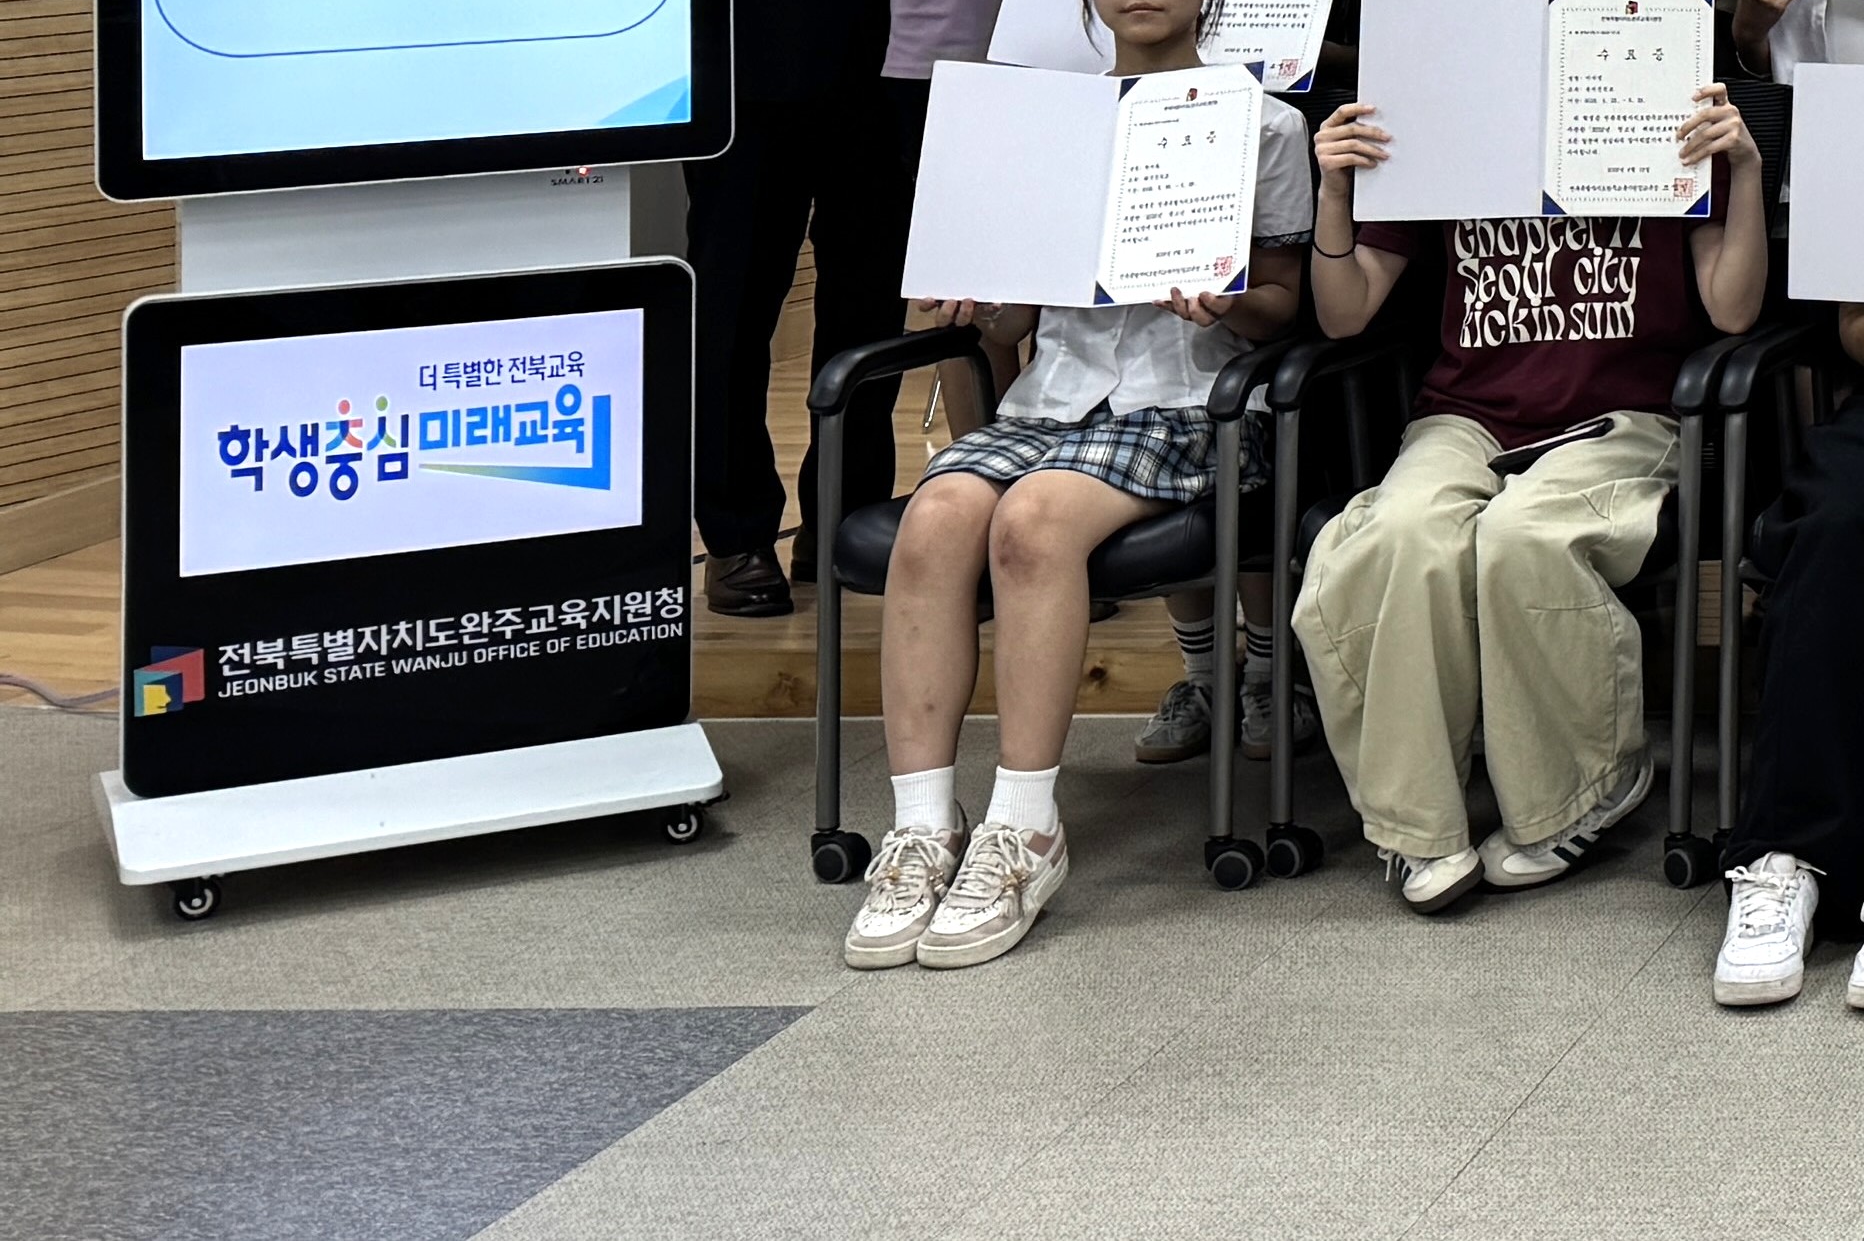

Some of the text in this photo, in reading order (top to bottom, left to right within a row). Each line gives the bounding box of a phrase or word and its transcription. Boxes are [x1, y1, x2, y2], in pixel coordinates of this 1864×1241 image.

[1457, 247, 1640, 304] Seoul city
[419, 350, 585, 391] 더 특별한 전북교육
[217, 384, 585, 501] 학생중심 미래교육
[217, 586, 686, 676] 전북특별자치도완주교육지원청
[218, 622, 684, 699] JEONBUK STATE WANJU OFFICE OF EDUCATION
